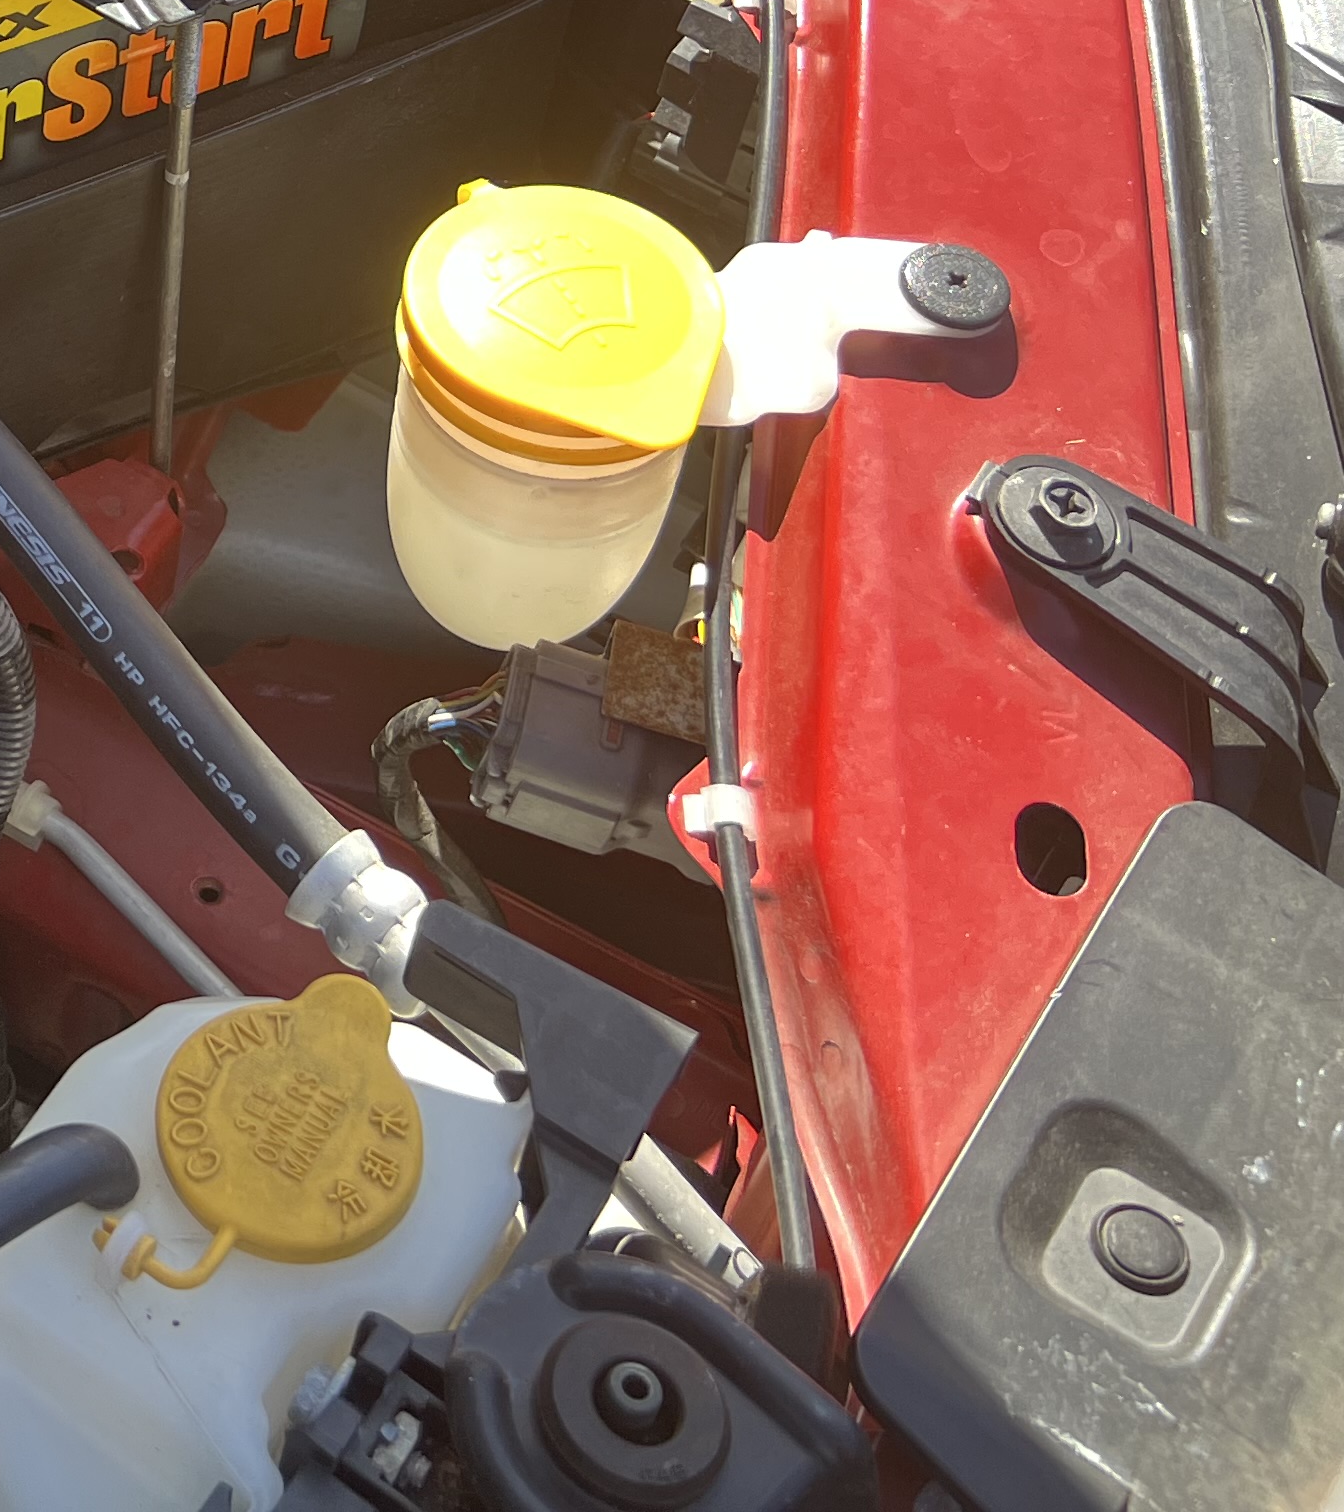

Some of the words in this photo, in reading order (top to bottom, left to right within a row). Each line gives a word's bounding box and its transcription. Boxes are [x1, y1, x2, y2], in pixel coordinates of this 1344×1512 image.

[77, 599, 106, 634] 11
[113, 650, 146, 688] HP
[148, 694, 257, 825] HFC-134a
[169, 1011, 291, 1185] COOLANT
[234, 1085, 278, 1135] SEE
[253, 1068, 321, 1165] OWNERS
[277, 1089, 349, 1183] MANUAL
[327, 1104, 410, 1223] 冷却水
